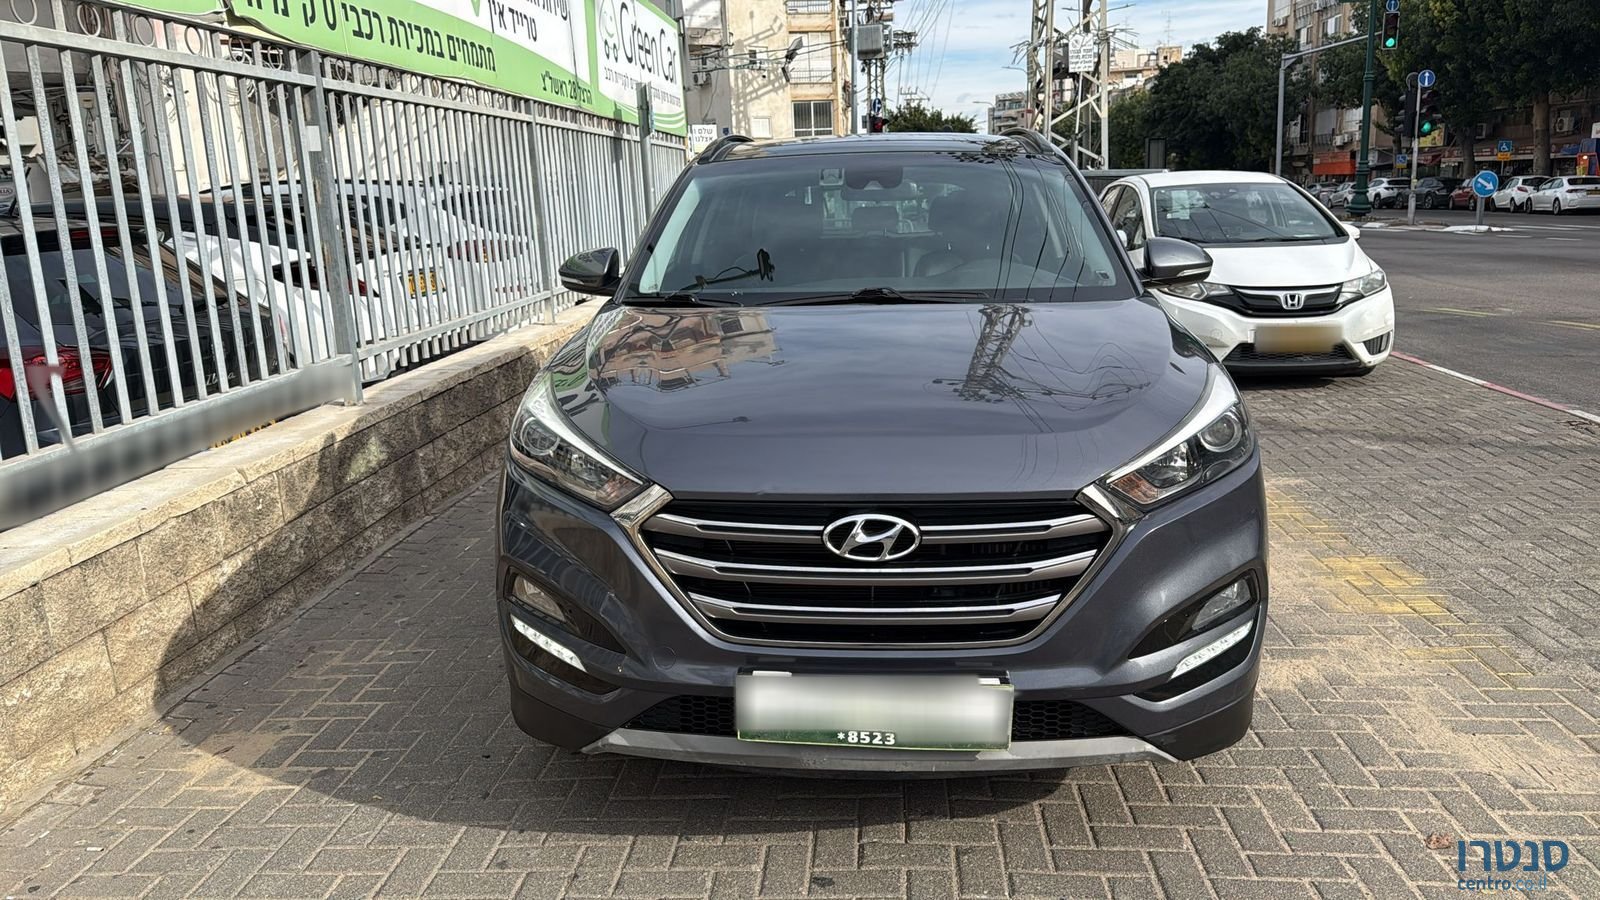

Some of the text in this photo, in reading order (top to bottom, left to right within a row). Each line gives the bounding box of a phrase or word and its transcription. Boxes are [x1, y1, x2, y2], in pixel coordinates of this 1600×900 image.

[341, 2, 385, 44] רכבי
[387, 16, 445, 59] במכירת
[487, 0, 538, 42] טרייד אין
[447, 34, 496, 72] מתמחים
[620, 2, 677, 85] Green Car
